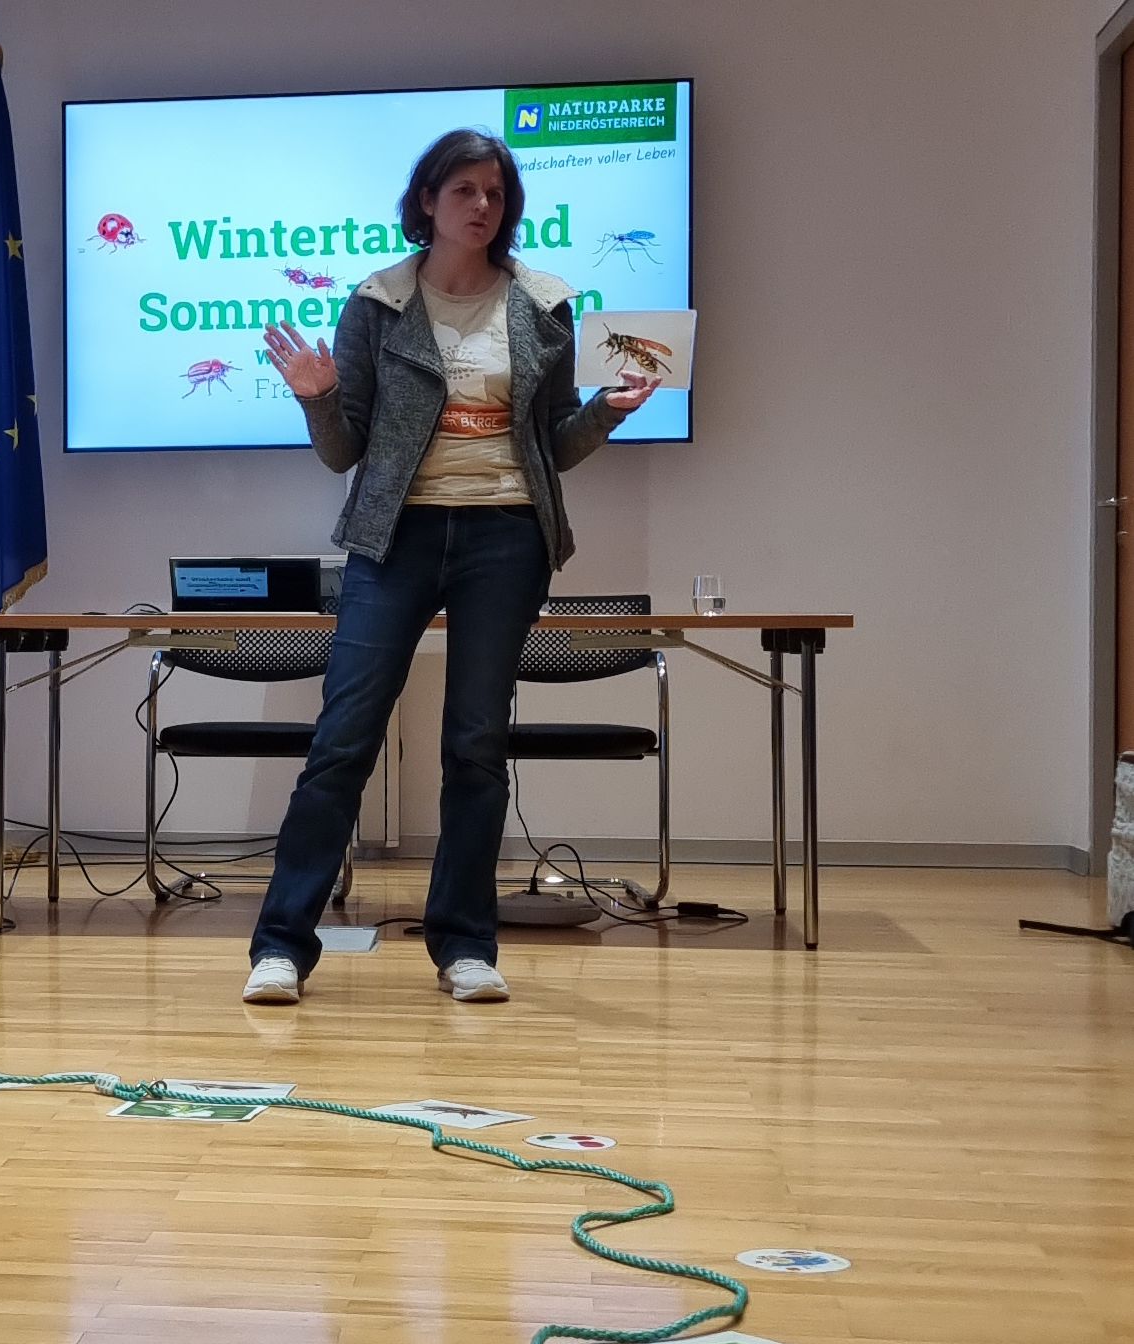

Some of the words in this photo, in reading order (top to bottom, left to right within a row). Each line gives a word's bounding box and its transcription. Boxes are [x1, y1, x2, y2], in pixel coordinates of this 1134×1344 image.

[548, 97, 666, 117] NATURPARKE
[548, 115, 665, 132] NIEDERÖSTERREICH
[519, 154, 592, 172] ndschaften
[598, 149, 632, 164] voller
[636, 146, 676, 161] Leben
[520, 203, 573, 249] nd
[461, 417, 499, 428] BERGE
